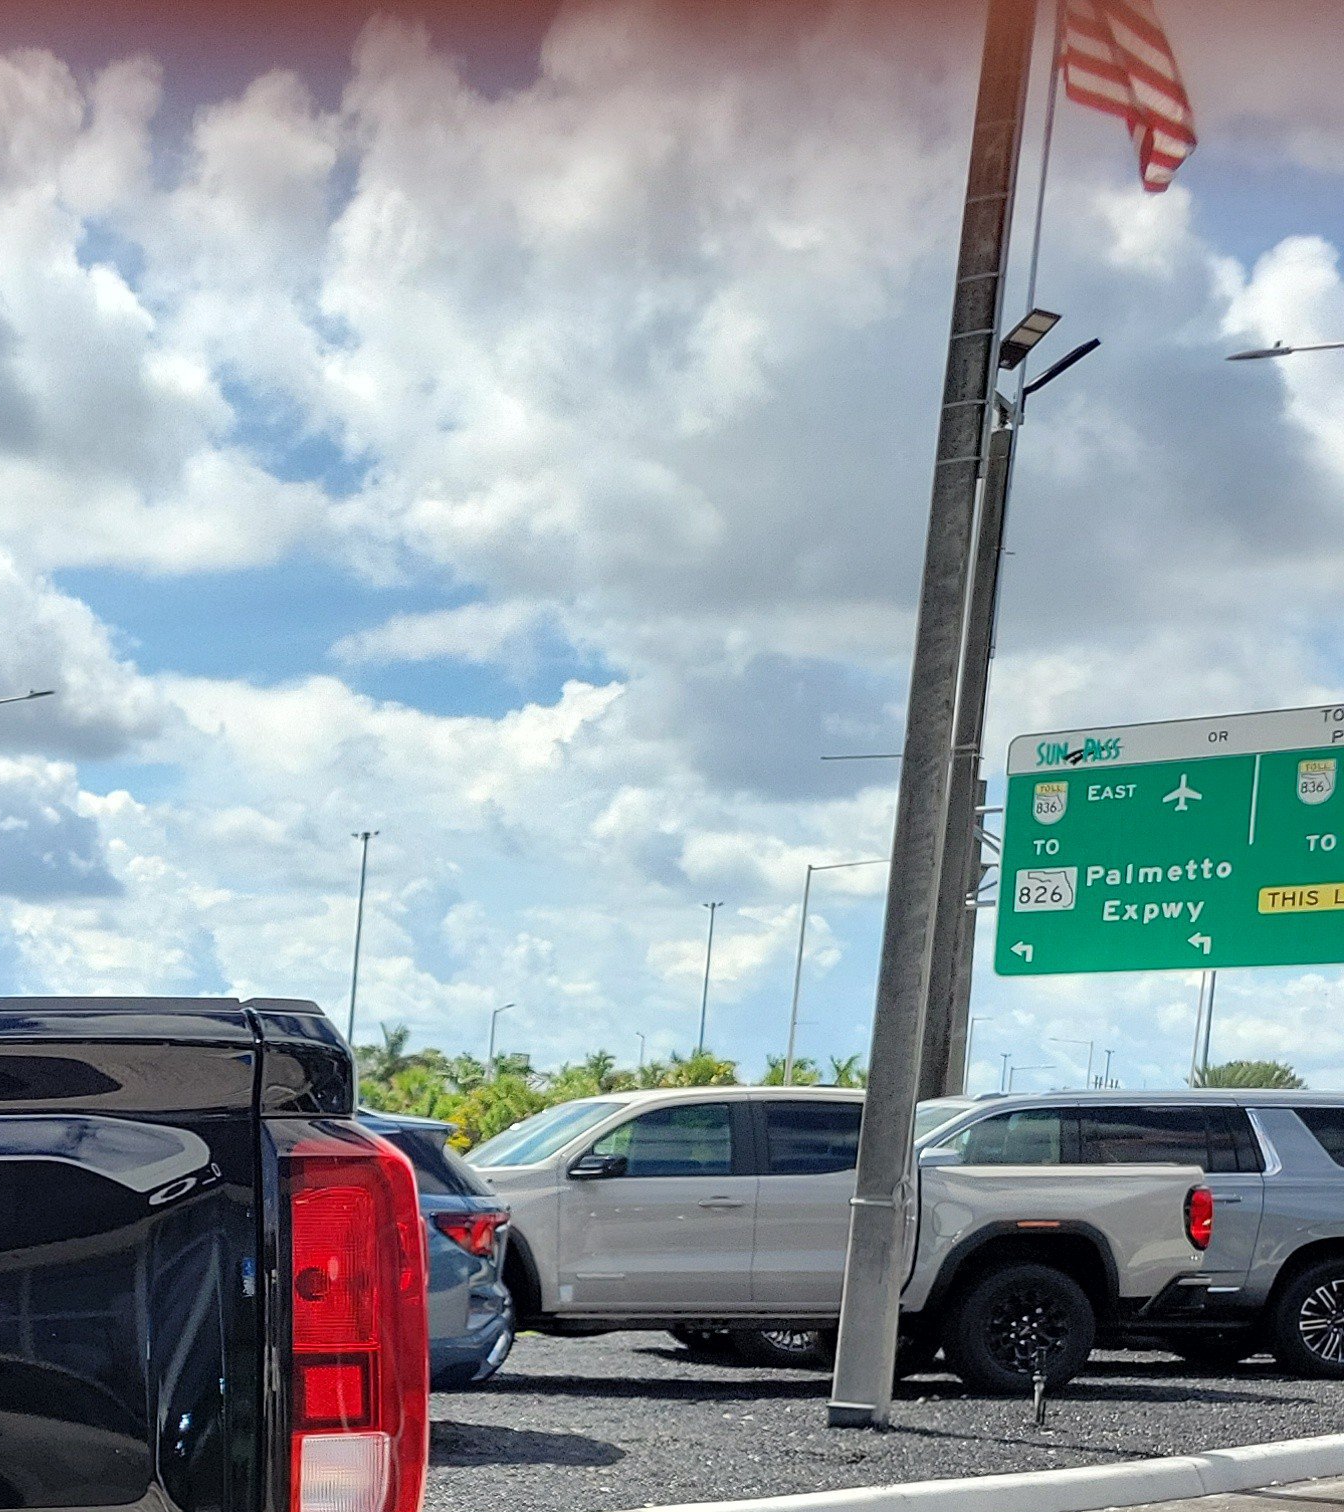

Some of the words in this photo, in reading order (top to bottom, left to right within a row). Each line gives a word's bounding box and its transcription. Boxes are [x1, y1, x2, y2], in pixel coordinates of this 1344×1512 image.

[1036, 741, 1069, 766] SUN
[1082, 738, 1121, 762] PASS
[1208, 730, 1229, 743] OR
[1305, 762, 1330, 772] TOLL
[1040, 784, 1062, 793] TOLL
[1088, 784, 1137, 801] EAST
[1300, 780, 1325, 794] 836
[1036, 801, 1057, 814] 836
[1033, 839, 1060, 855] TO
[1305, 834, 1337, 852] TO
[1086, 858, 1233, 886] Palmetto
[1018, 885, 1063, 904] 826
[1268, 889, 1320, 908] THIS
[1102, 899, 1204, 924] Expwy
